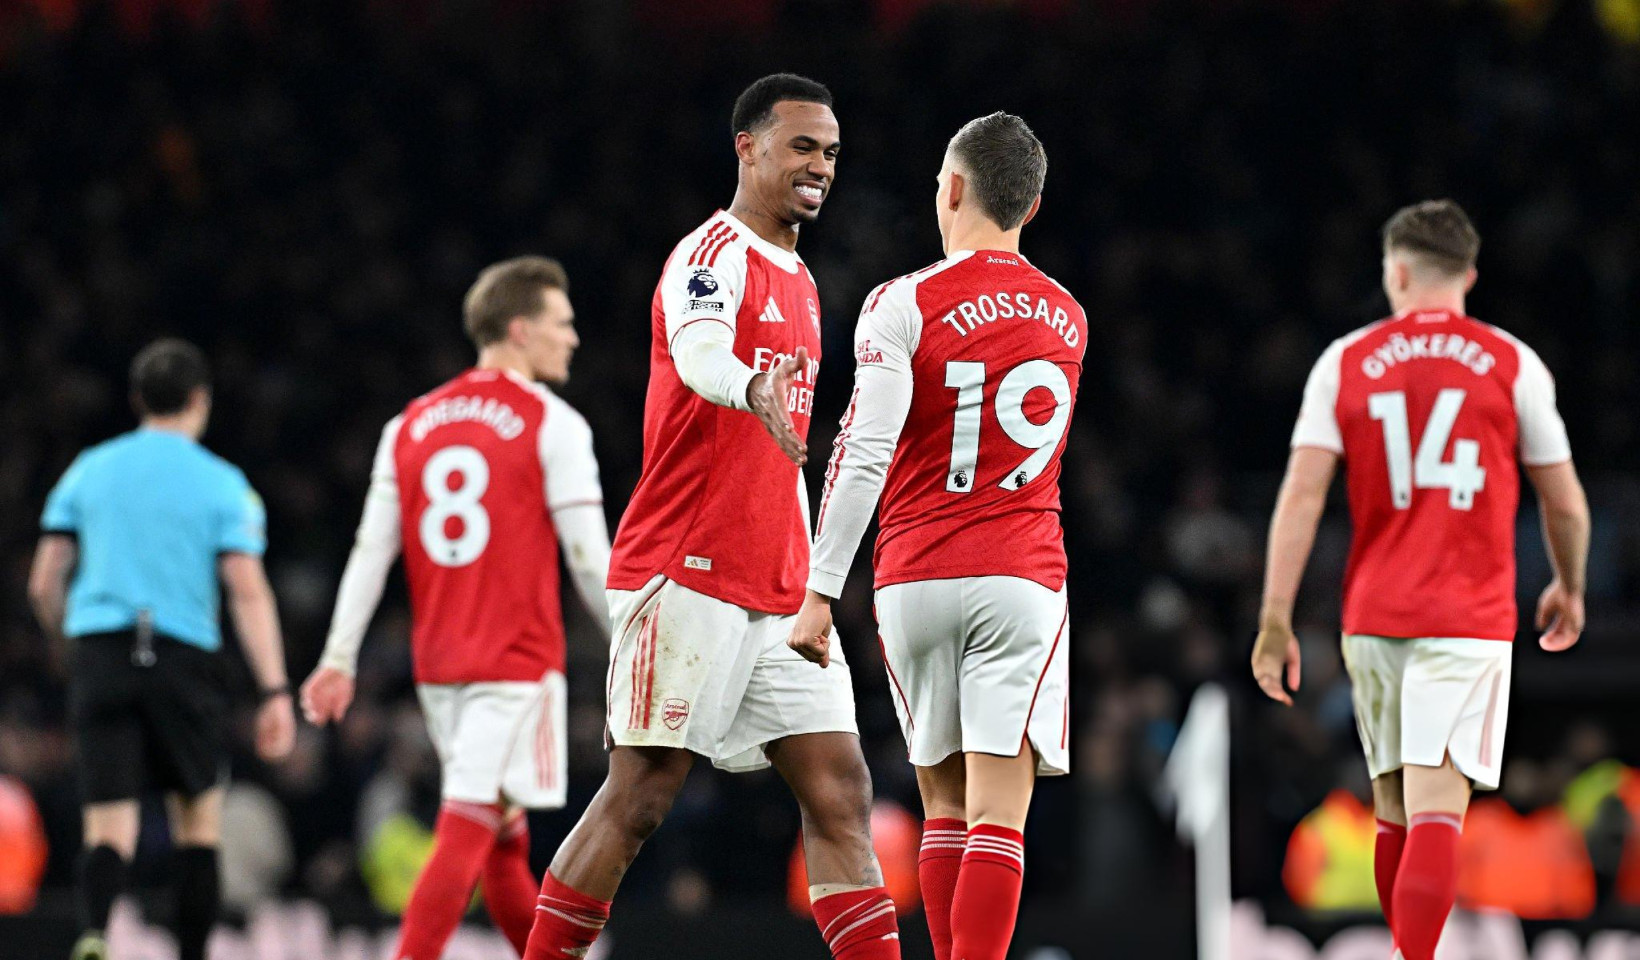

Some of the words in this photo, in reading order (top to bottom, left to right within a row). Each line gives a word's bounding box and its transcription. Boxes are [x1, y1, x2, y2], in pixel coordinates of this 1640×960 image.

[942, 292, 1079, 348] TROSSARD
[945, 359, 1072, 493] 19
[1367, 387, 1487, 511] 14
[419, 444, 491, 568] 8
